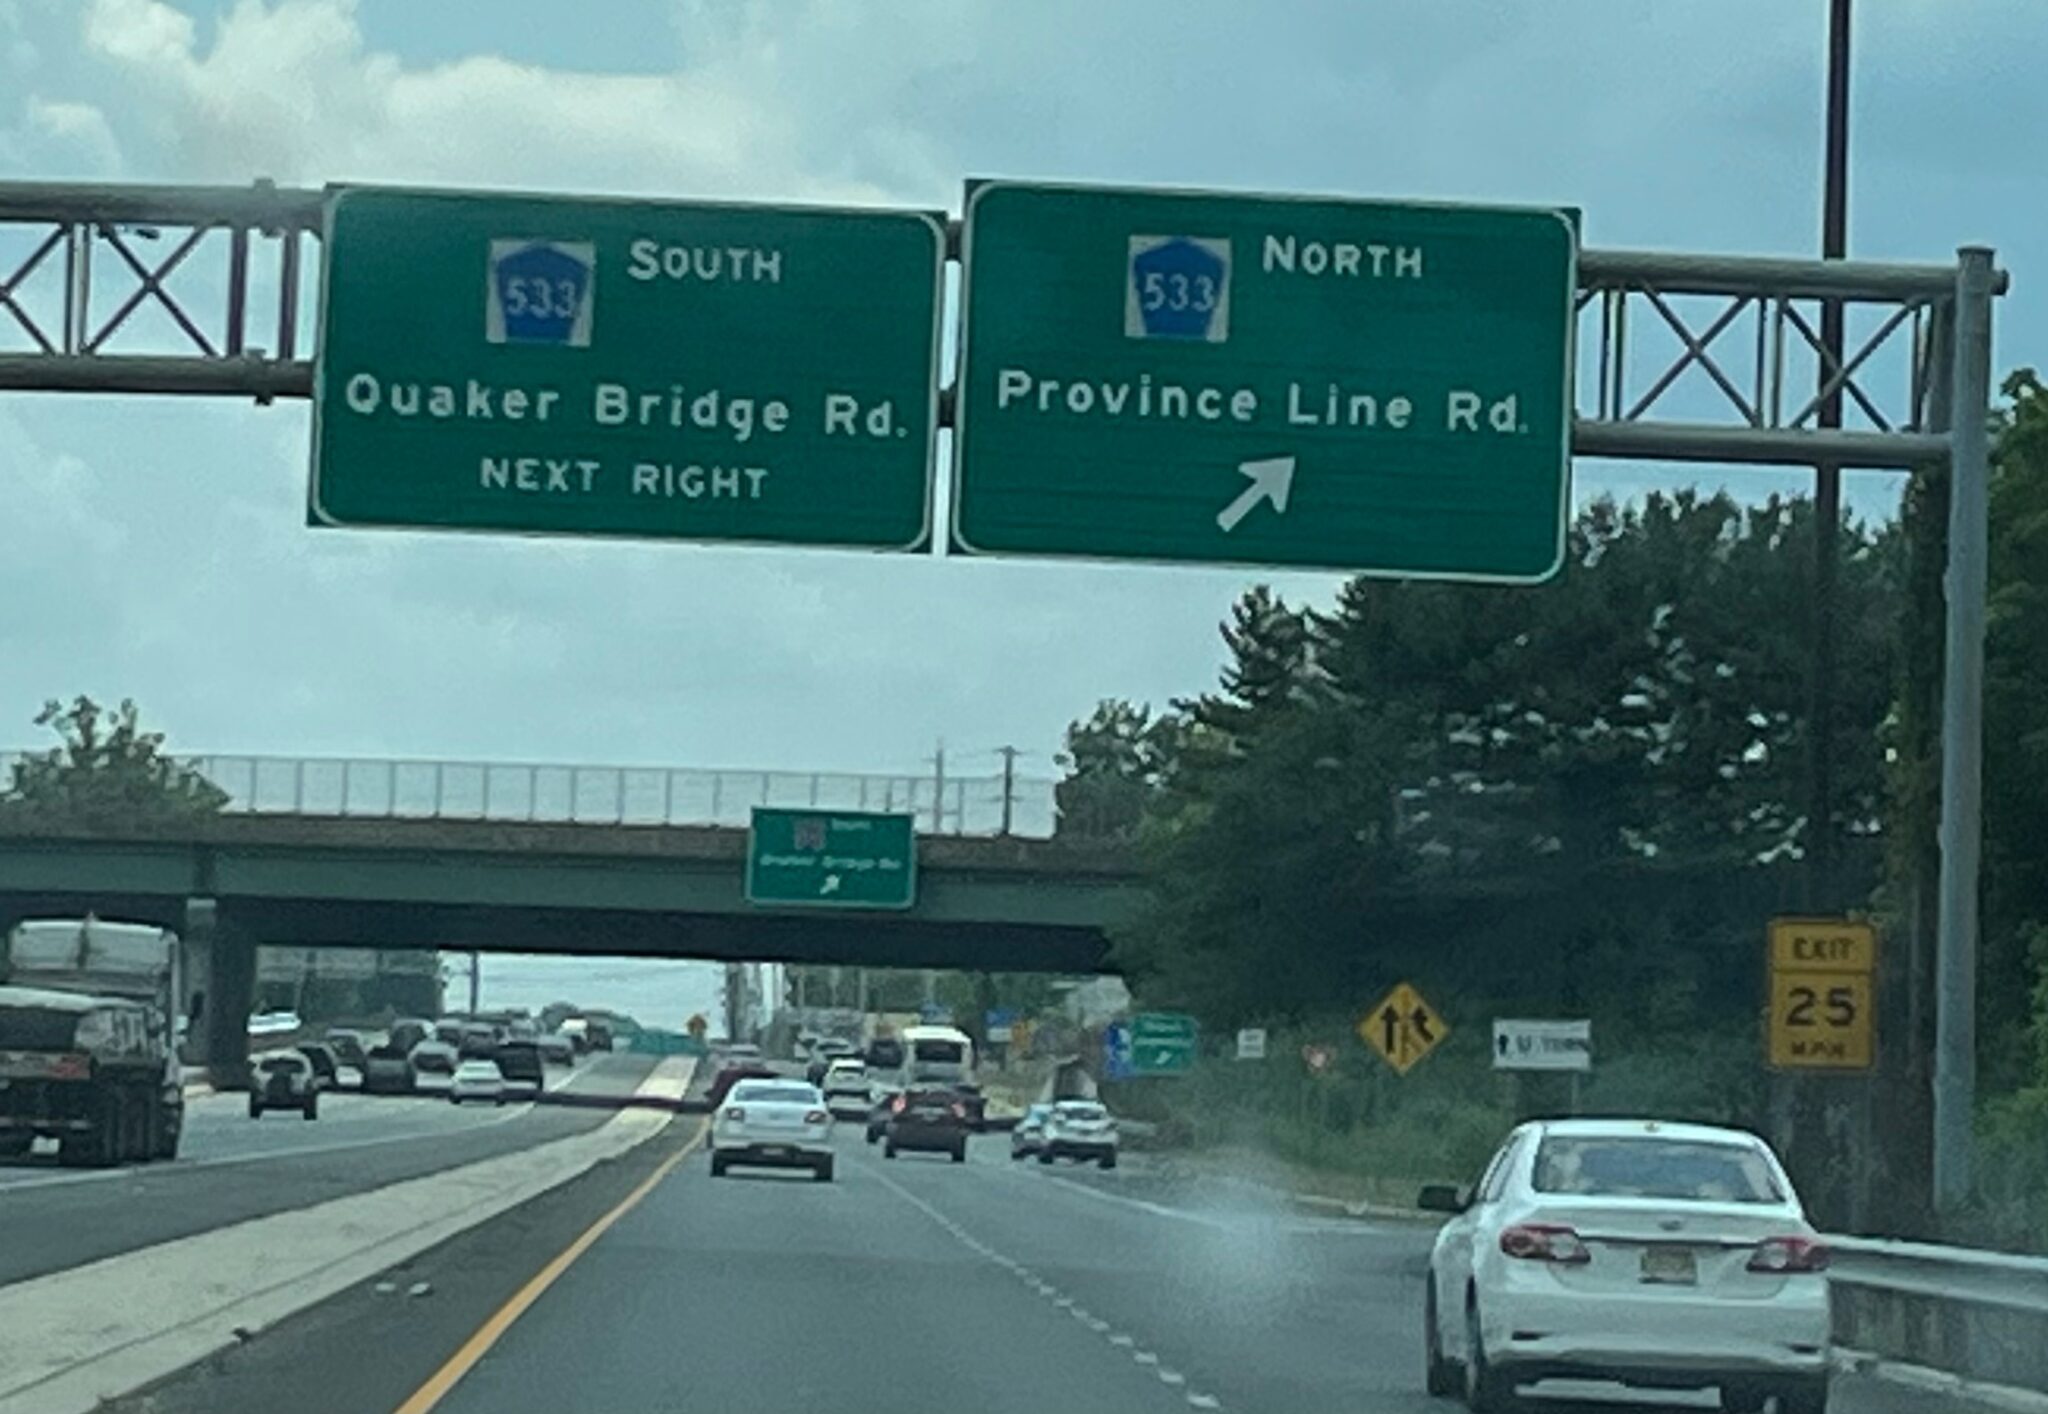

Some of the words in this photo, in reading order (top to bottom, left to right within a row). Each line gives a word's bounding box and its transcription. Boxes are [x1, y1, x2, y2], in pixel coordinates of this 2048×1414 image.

[504, 276, 579, 318] 533
[1143, 271, 1216, 313] 533
[345, 372, 560, 422] Quaker
[595, 383, 791, 442] Bridge
[824, 393, 910, 437] Rd.
[997, 368, 1259, 425] Province
[1288, 382, 1413, 430] Line
[1448, 391, 1530, 434] Rd.
[480, 457, 601, 492] NEXT
[632, 463, 770, 499] RIGHT
[1793, 936, 1855, 960] EXIT
[1785, 987, 1857, 1027] 25
